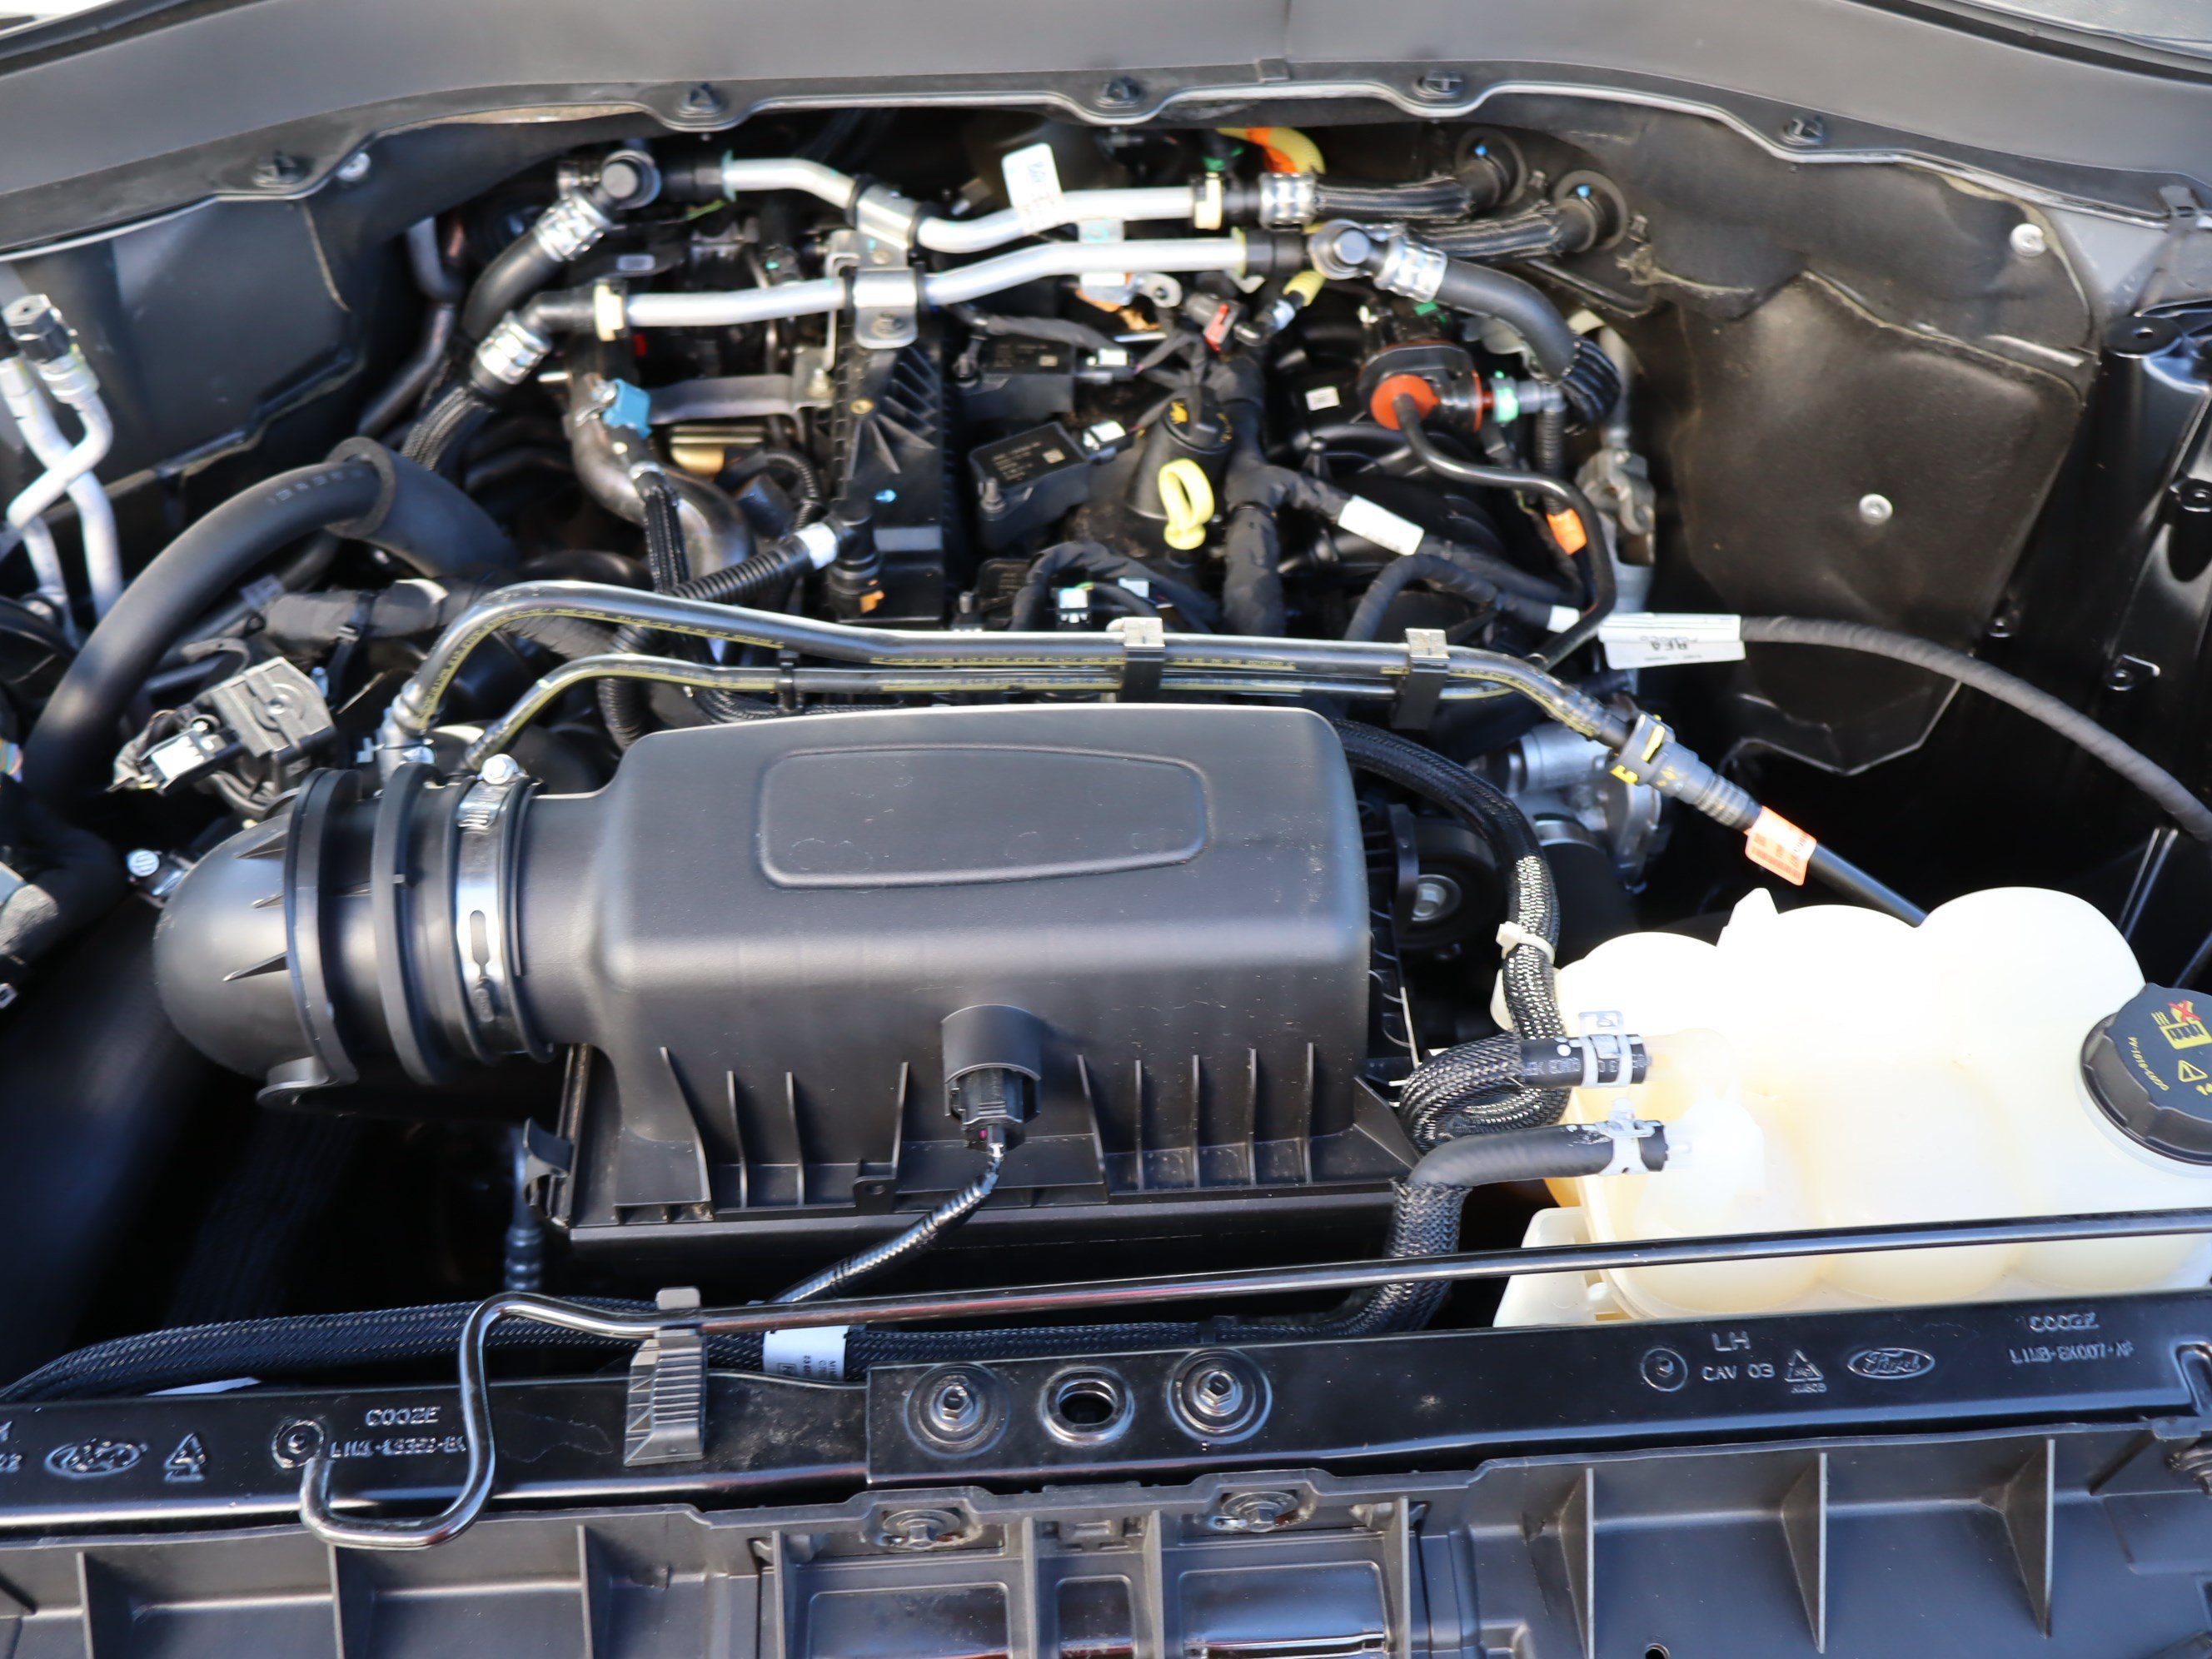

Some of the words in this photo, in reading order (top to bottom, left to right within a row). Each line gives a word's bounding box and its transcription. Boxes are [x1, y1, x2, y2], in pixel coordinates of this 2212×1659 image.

[1711, 1331, 1751, 1352] LH
[1863, 1348, 1922, 1375] Ford
[1702, 1364, 1737, 1382] CAV
[1747, 1363, 1776, 1379] 03
